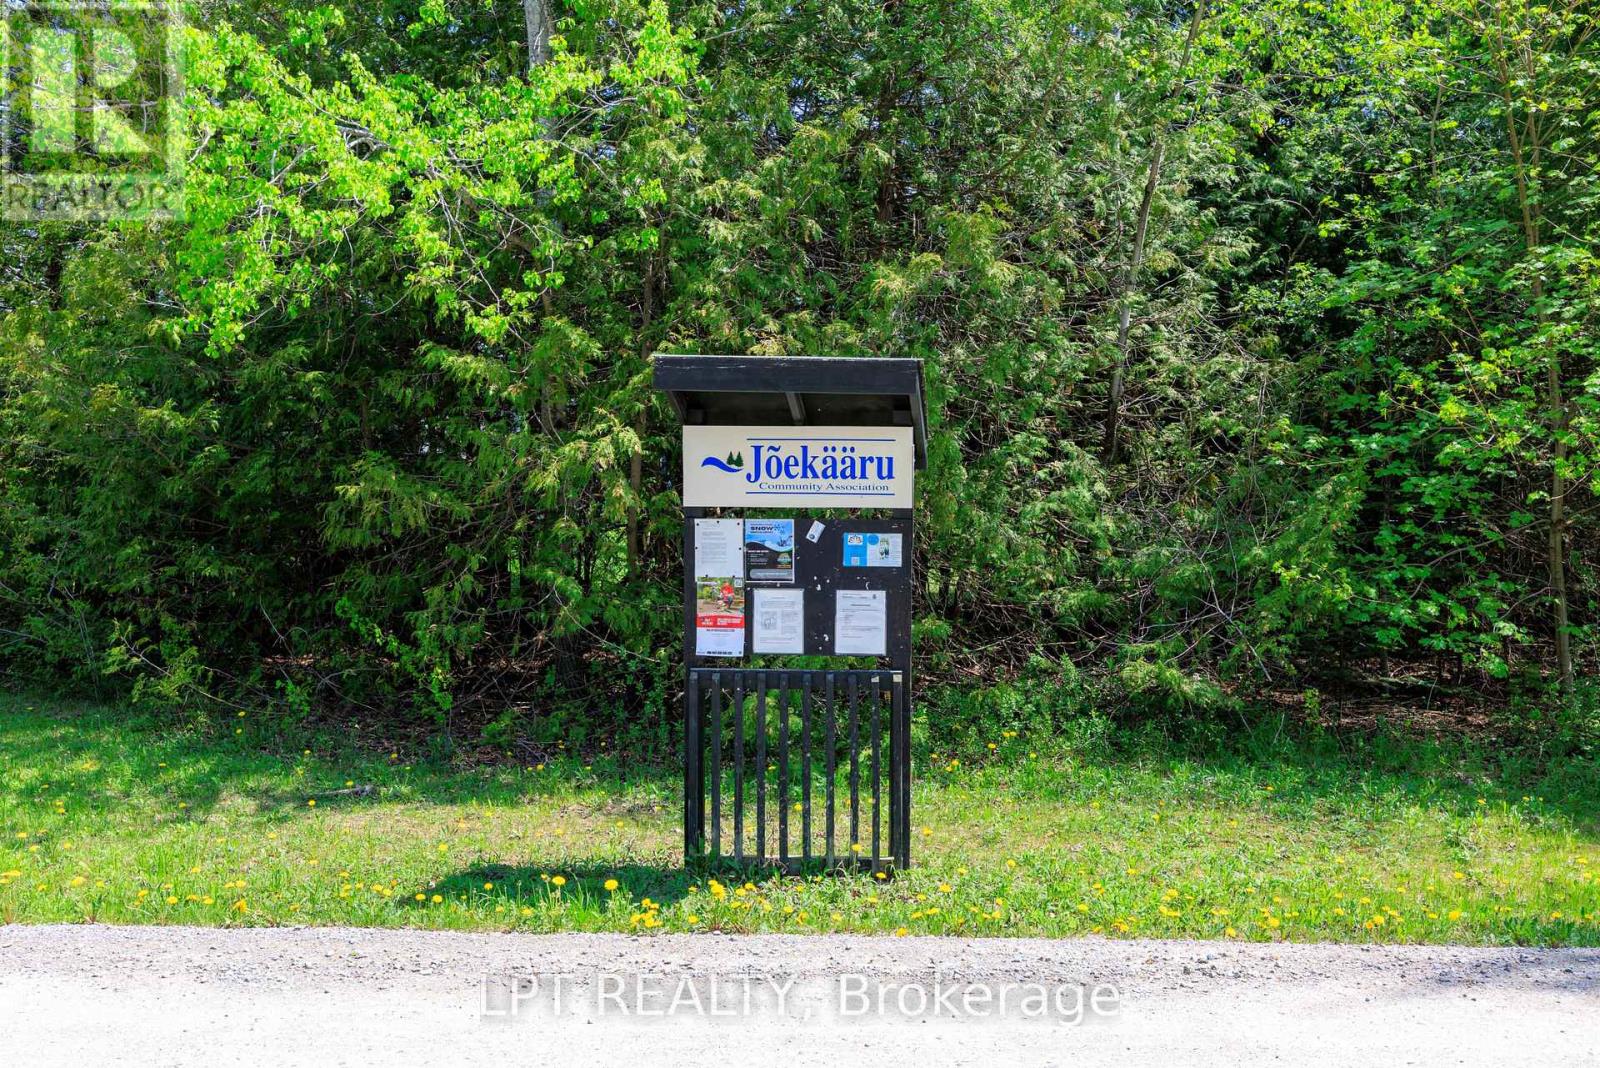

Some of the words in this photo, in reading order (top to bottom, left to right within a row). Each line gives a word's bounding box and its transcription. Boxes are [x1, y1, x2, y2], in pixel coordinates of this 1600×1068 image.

[746, 445, 895, 483] Jõekääru
[759, 482, 822, 492] Community
[826, 482, 889, 492] Association
